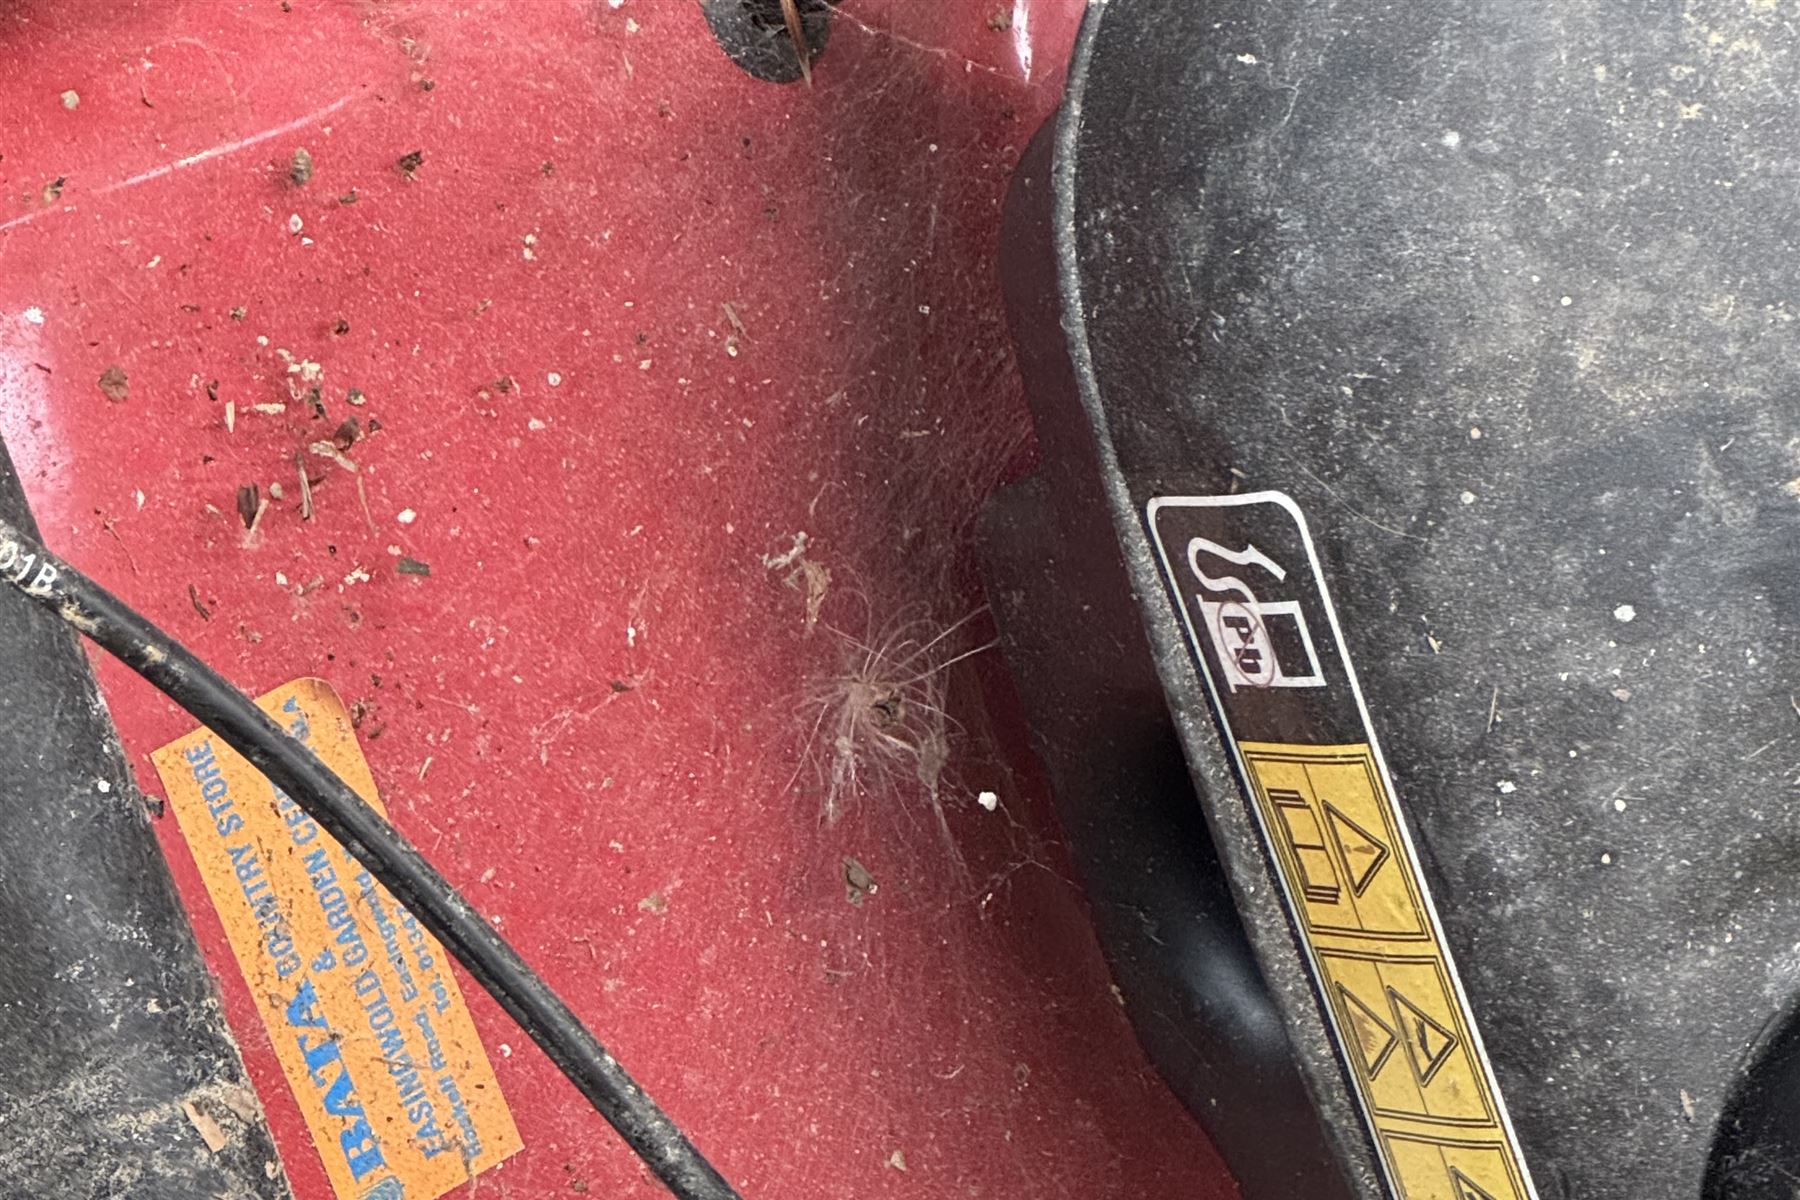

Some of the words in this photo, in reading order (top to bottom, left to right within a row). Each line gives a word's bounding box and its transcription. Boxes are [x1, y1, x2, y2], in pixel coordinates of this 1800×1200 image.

[1222, 616, 1262, 673] Pb
[185, 739, 245, 836] STORE
[227, 843, 302, 977] COUNTRY
[302, 847, 368, 967] GARDEN
[310, 949, 337, 973] &
[286, 976, 387, 1183] BATA
[354, 968, 443, 1159] EASINGWOLD
